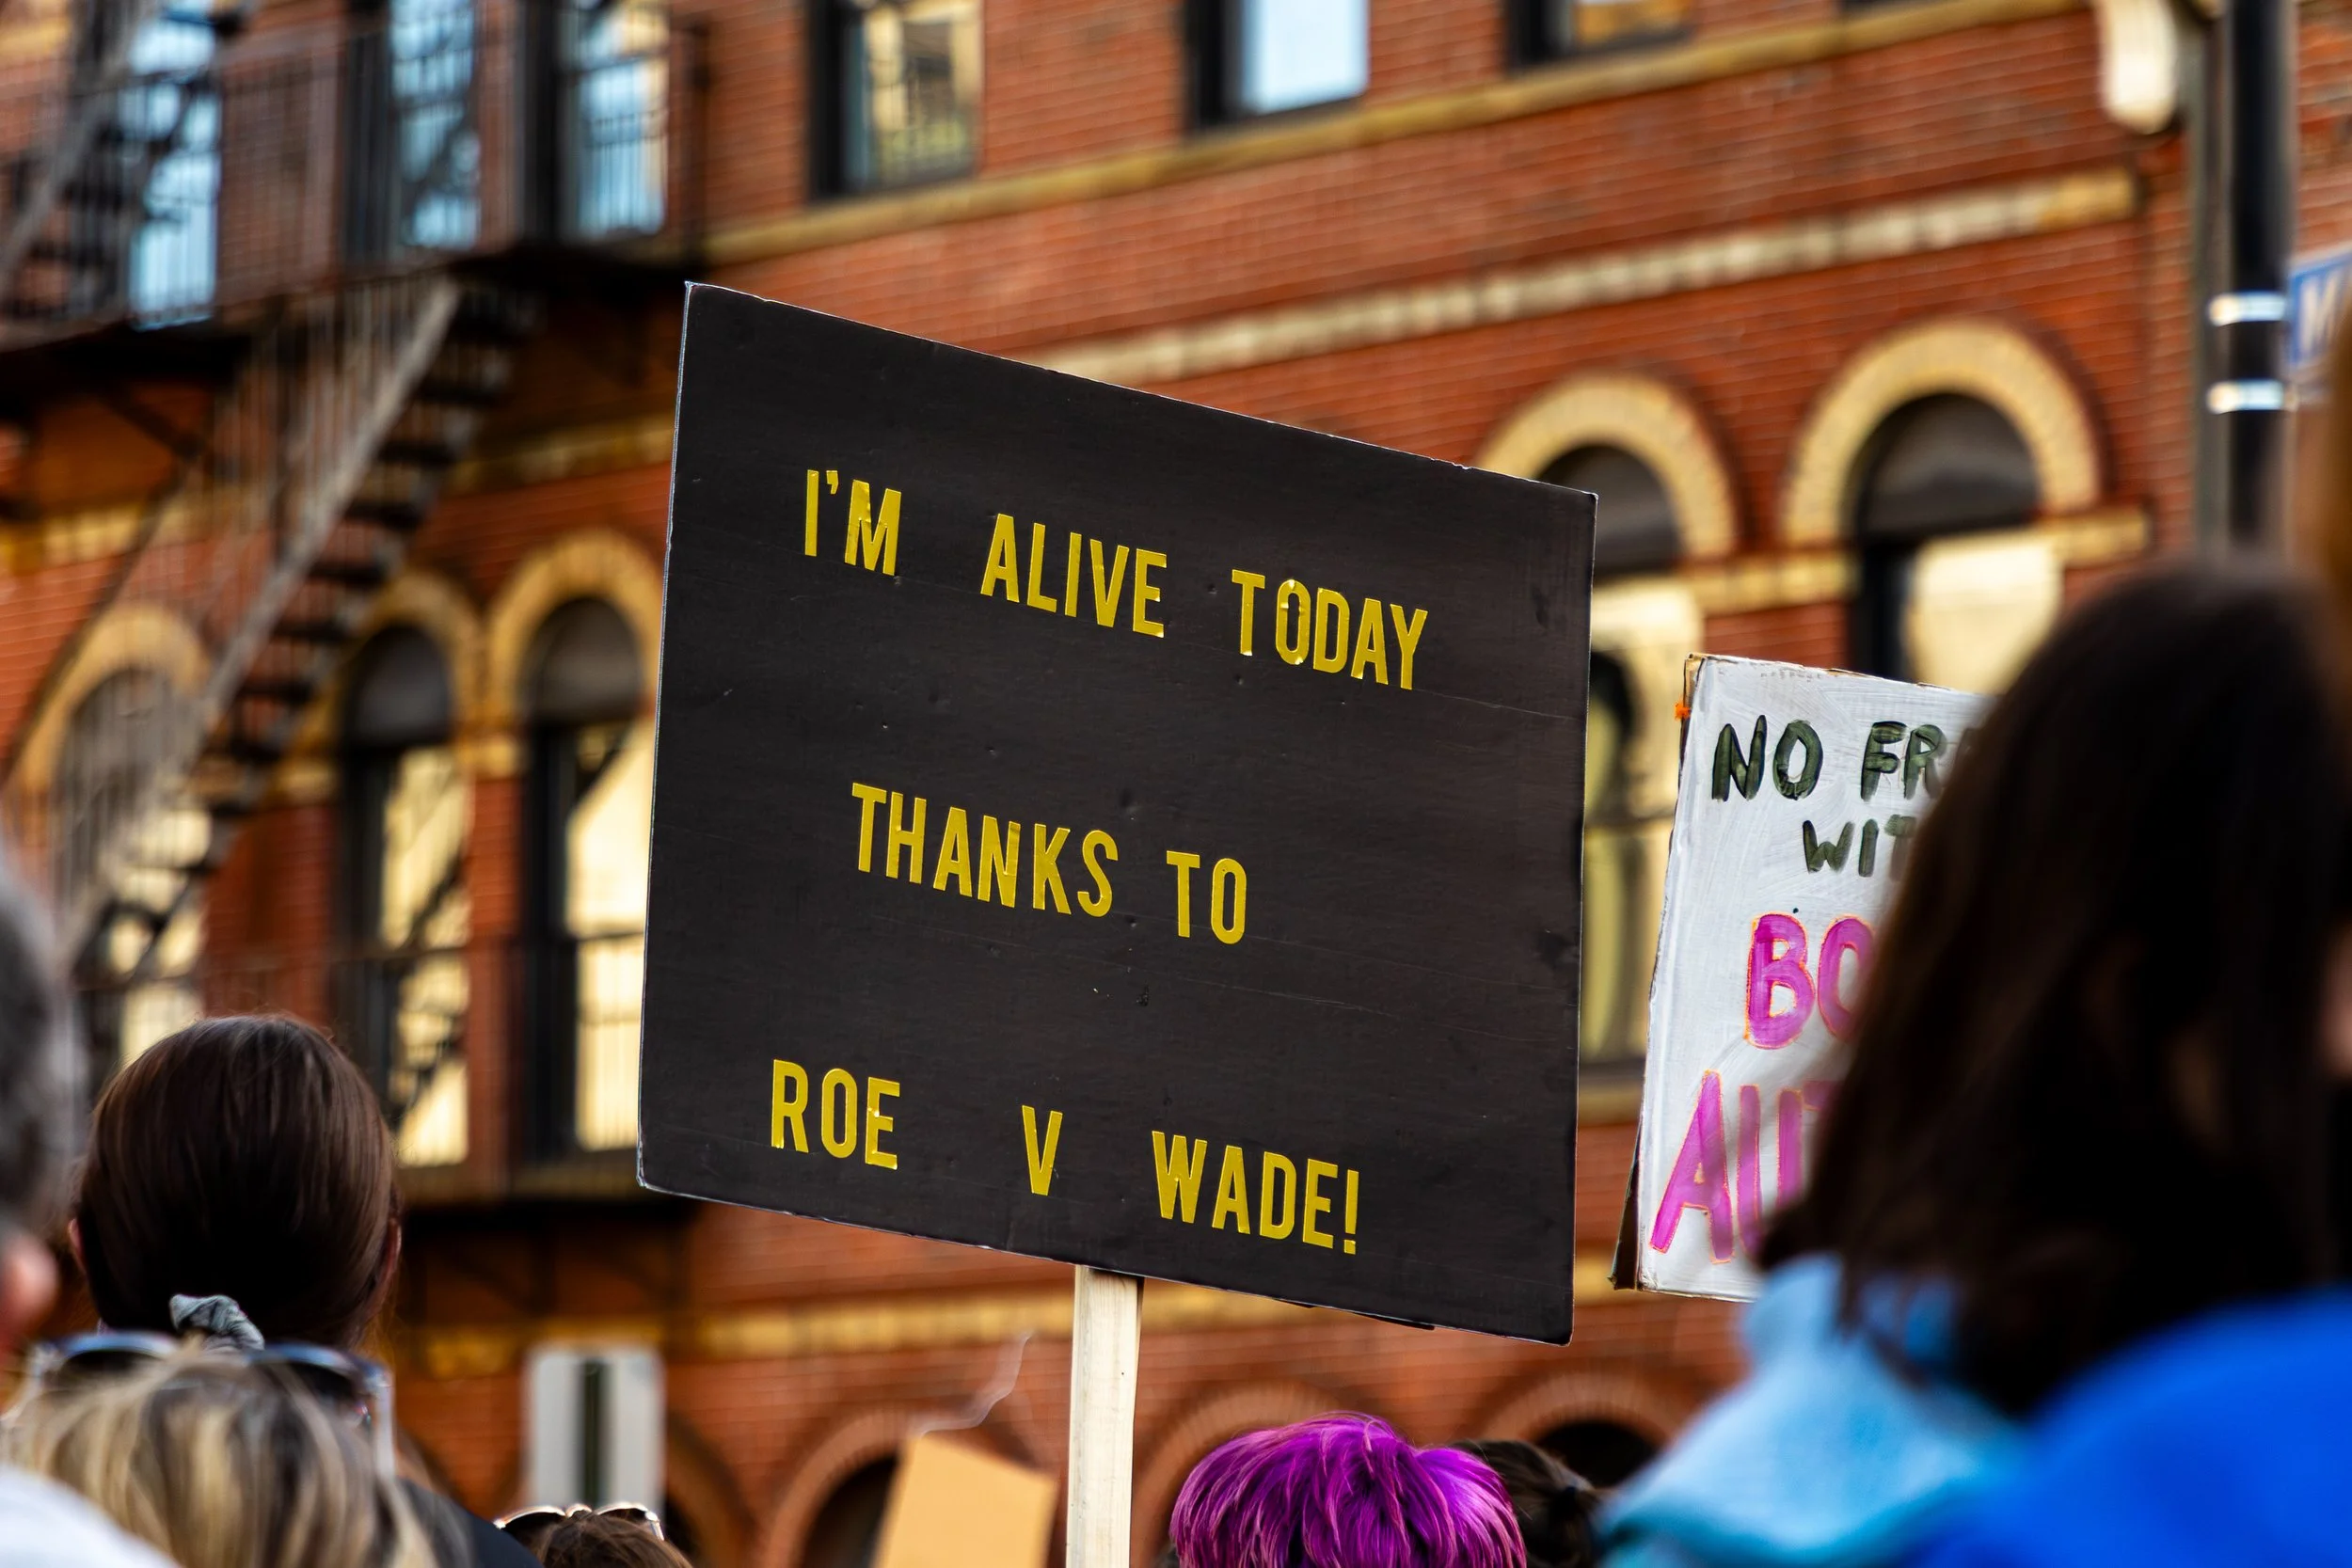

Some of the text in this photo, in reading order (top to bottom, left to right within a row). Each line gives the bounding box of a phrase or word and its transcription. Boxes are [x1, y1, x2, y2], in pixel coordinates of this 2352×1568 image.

[804, 468, 1428, 689] I'M ALIVE TODAY
[1711, 715, 1968, 801] NO FR
[852, 782, 1248, 945] THANKS TO
[771, 1058, 1359, 1255] ROE V WADE!
